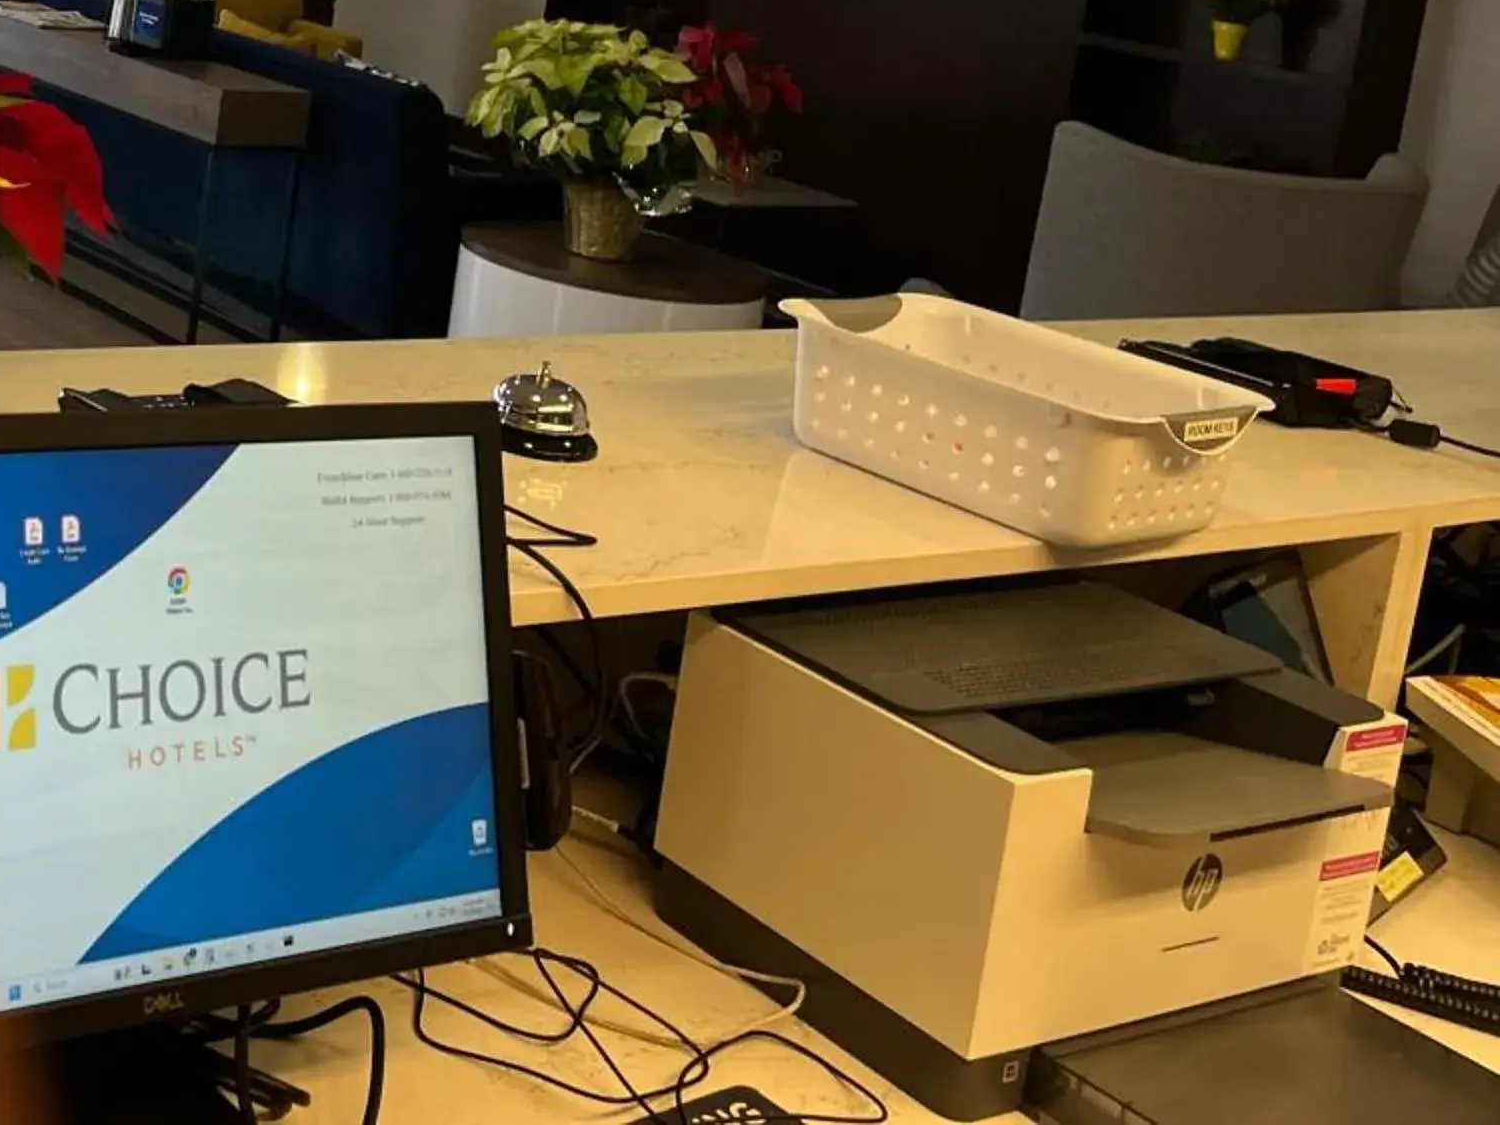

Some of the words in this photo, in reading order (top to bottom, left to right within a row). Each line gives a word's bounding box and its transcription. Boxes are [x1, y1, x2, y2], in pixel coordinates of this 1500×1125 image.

[52, 648, 312, 735] CHOICE
[1184, 856, 1220, 913] hp
[143, 990, 185, 1016] DELL
